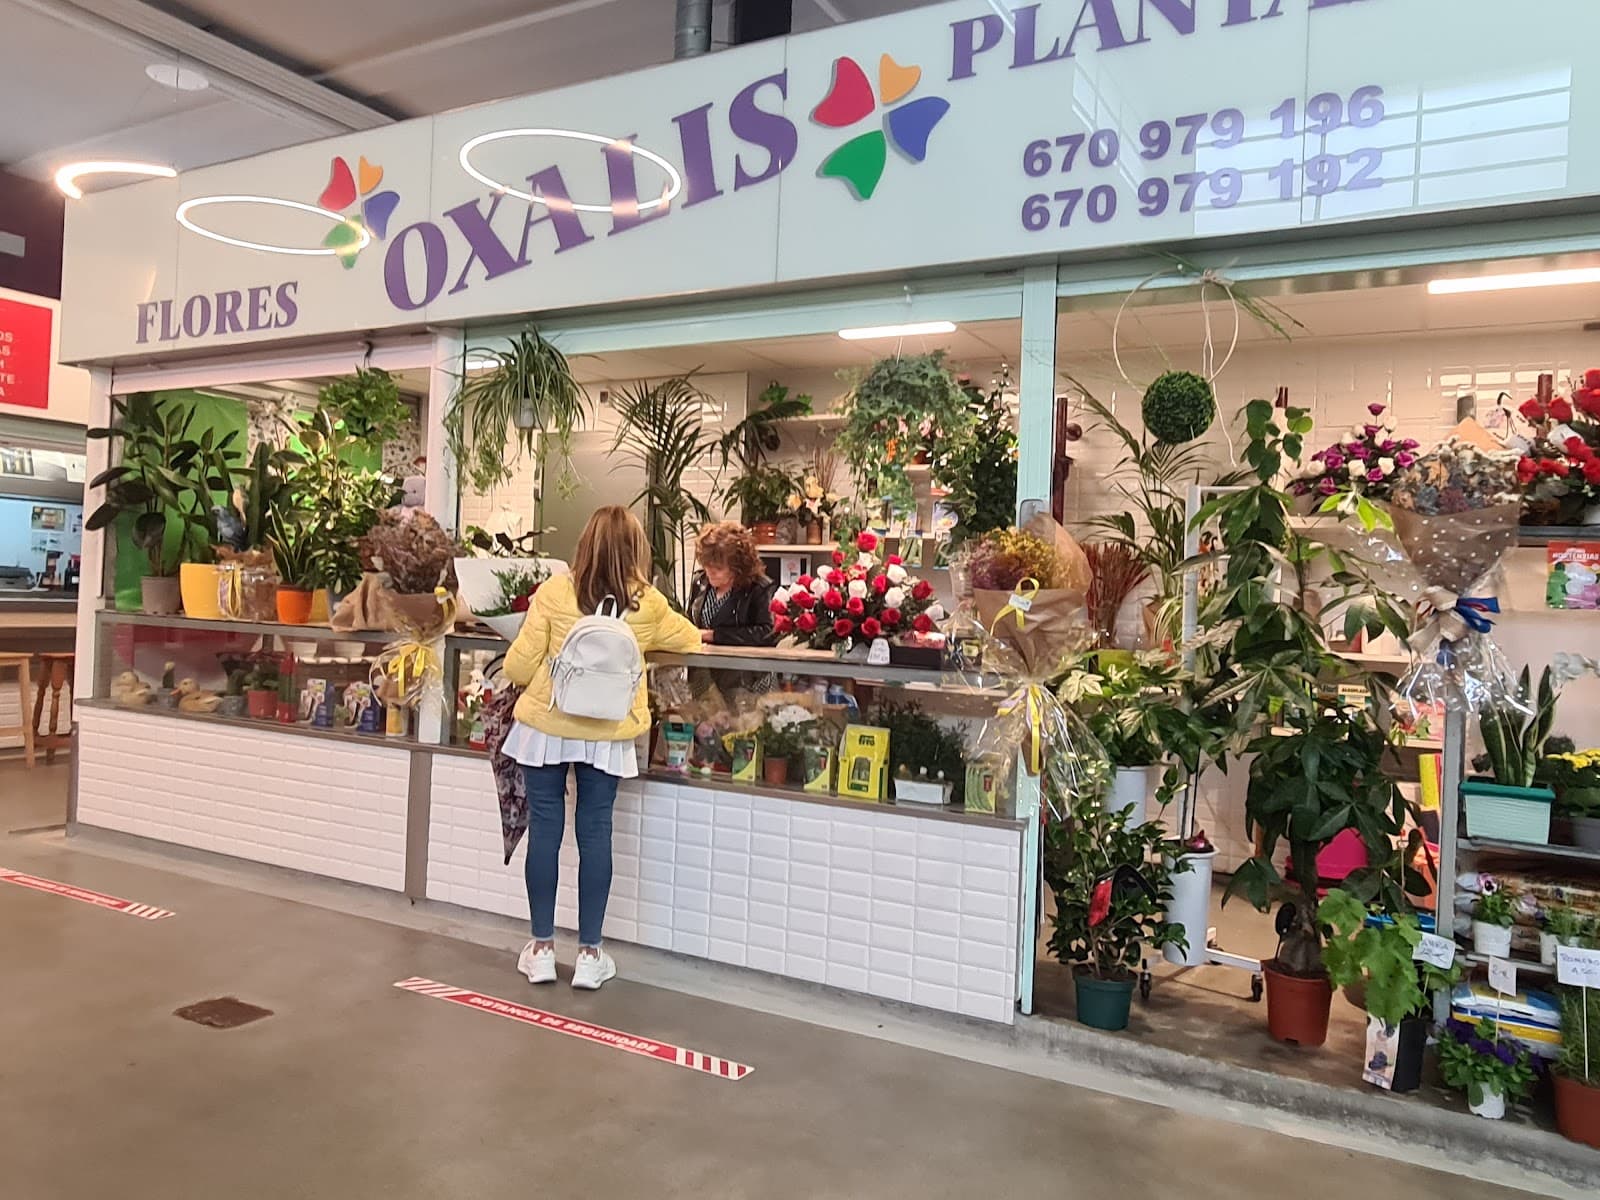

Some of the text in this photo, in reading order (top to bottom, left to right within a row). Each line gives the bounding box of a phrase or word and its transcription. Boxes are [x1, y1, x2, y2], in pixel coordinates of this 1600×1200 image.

[1022, 84, 1385, 178] 670 979 196
[136, 281, 298, 344] FLORES
[384, 68, 798, 311] OXALIS
[1020, 147, 1384, 232] 670 979 192
[469, 996, 541, 1021] DISTANCIA
[541, 1016, 564, 1026] DE
[563, 1022, 661, 1053] SEGURIDADE
